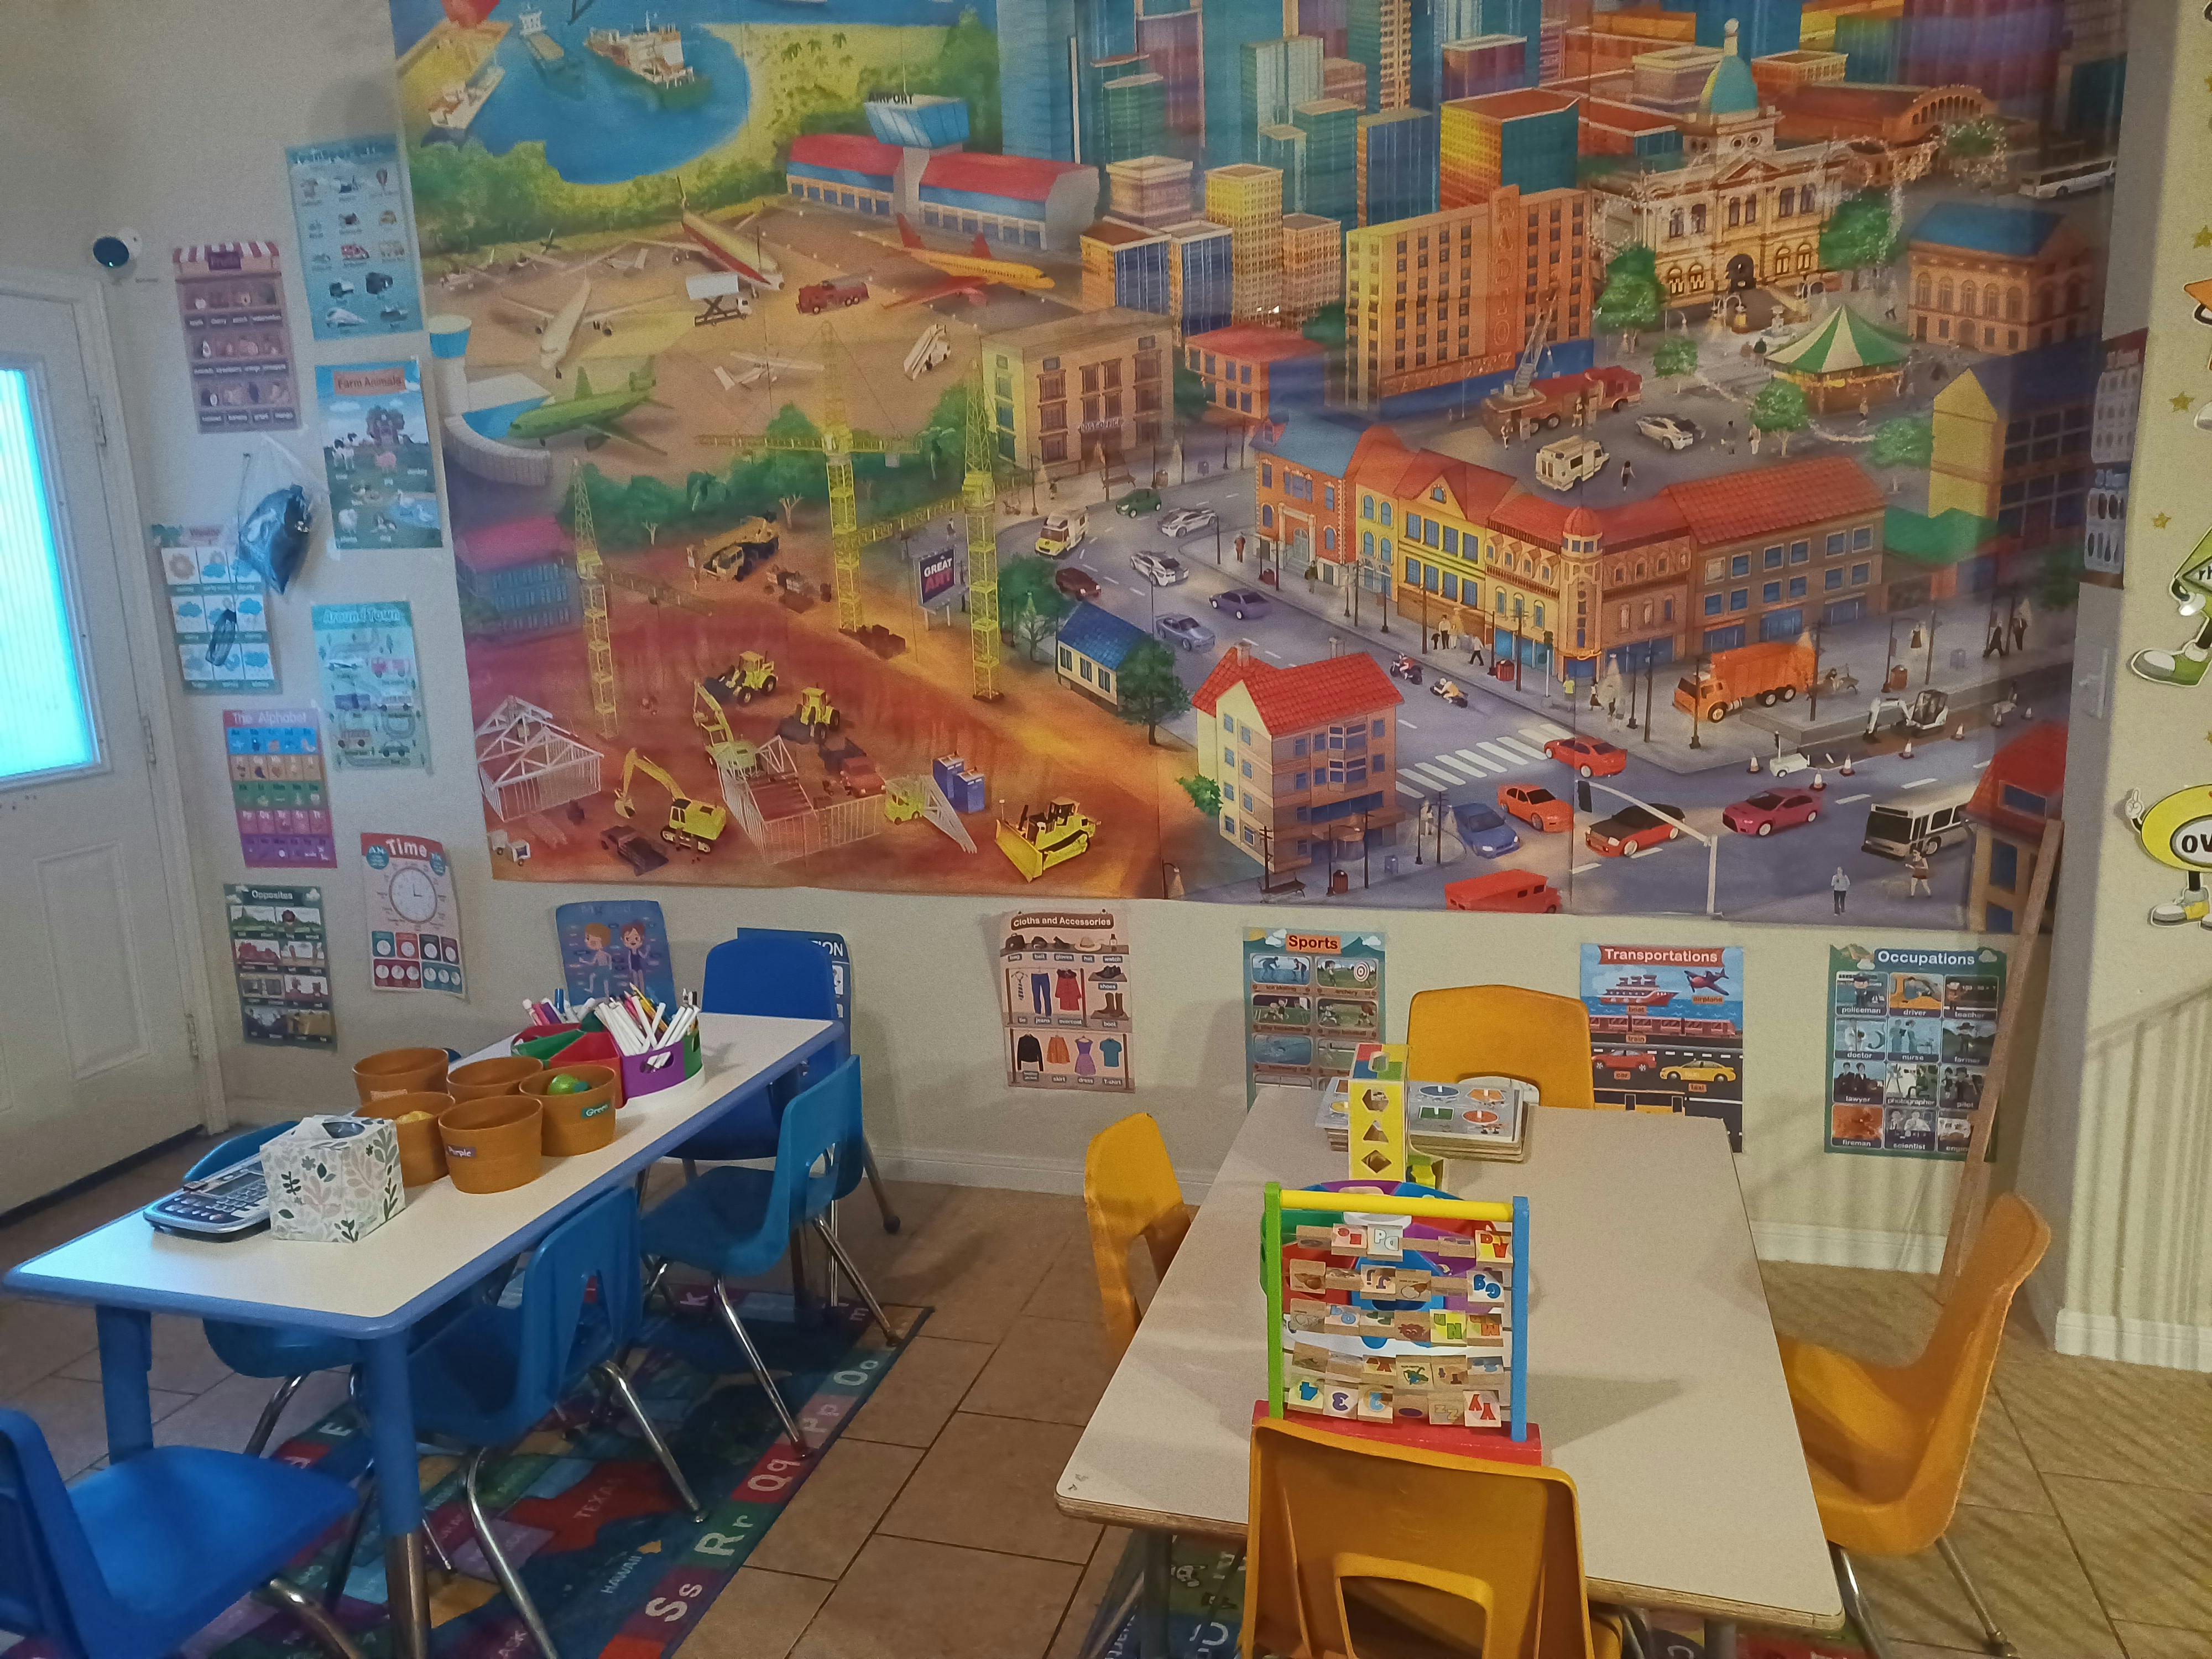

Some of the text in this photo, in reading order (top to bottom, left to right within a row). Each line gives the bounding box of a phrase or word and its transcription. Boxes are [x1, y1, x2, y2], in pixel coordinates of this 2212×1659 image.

[868, 92, 914, 105] AIRPORT
[338, 378, 362, 390] Farm
[924, 557, 952, 577] GREAT
[385, 838, 427, 857] Time
[1013, 916, 1111, 927] Cloths and Accessories
[1288, 935, 1338, 950] Sports
[1604, 948, 1718, 963] Transportations
[1877, 950, 1975, 966] Occupations
[1845, 1095, 1871, 1104] lawyer
[1887, 1097, 1936, 1106] photographer
[585, 1104, 608, 1117] Green
[447, 1145, 472, 1157] Purple
